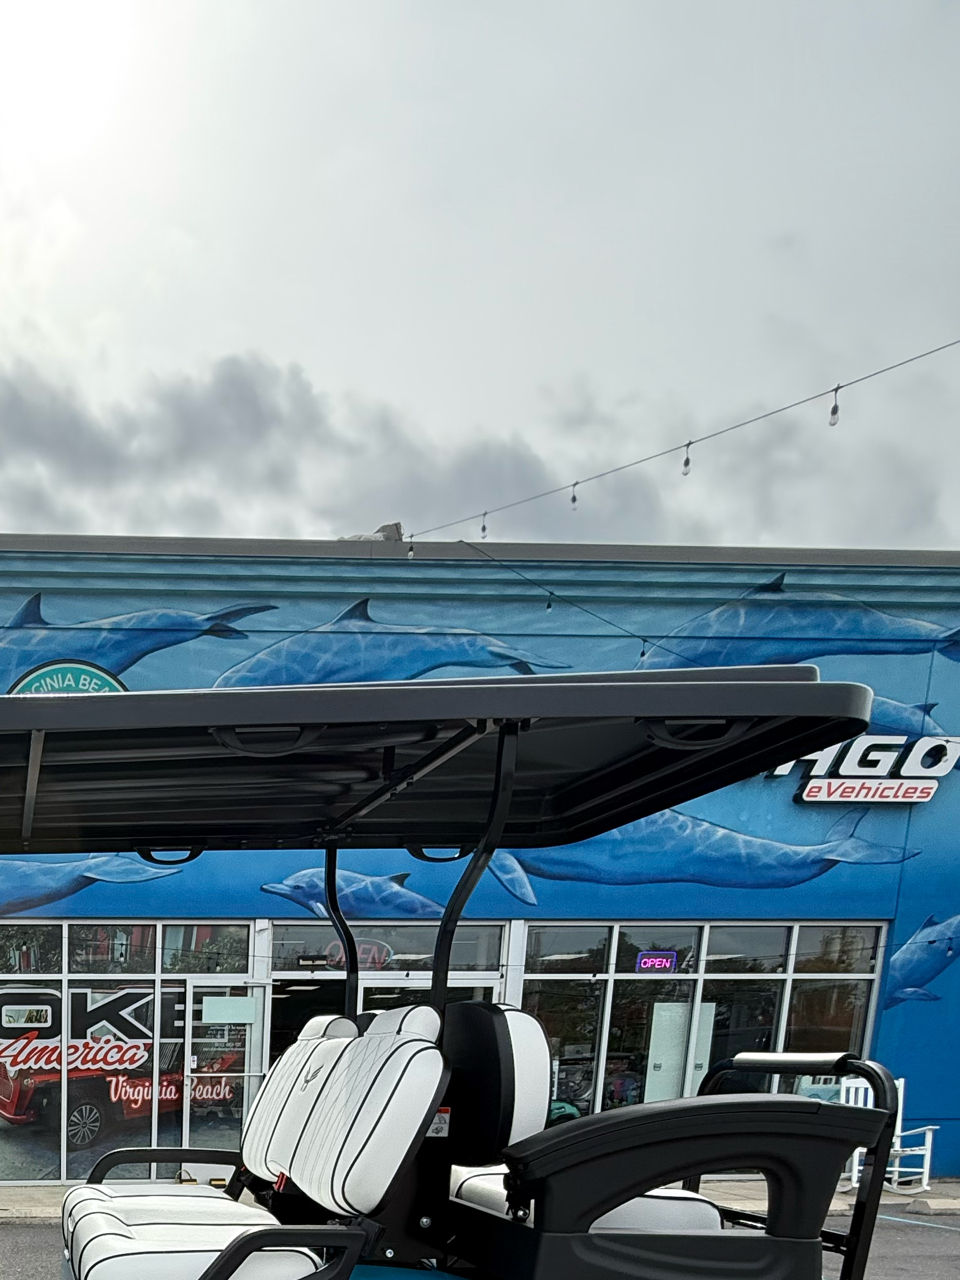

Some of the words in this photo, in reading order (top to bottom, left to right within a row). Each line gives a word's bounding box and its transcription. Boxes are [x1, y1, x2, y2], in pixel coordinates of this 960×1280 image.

[805, 782, 934, 799] eVehicles
[324, 940, 388, 969] OEN
[640, 957, 672, 969] OPEN
